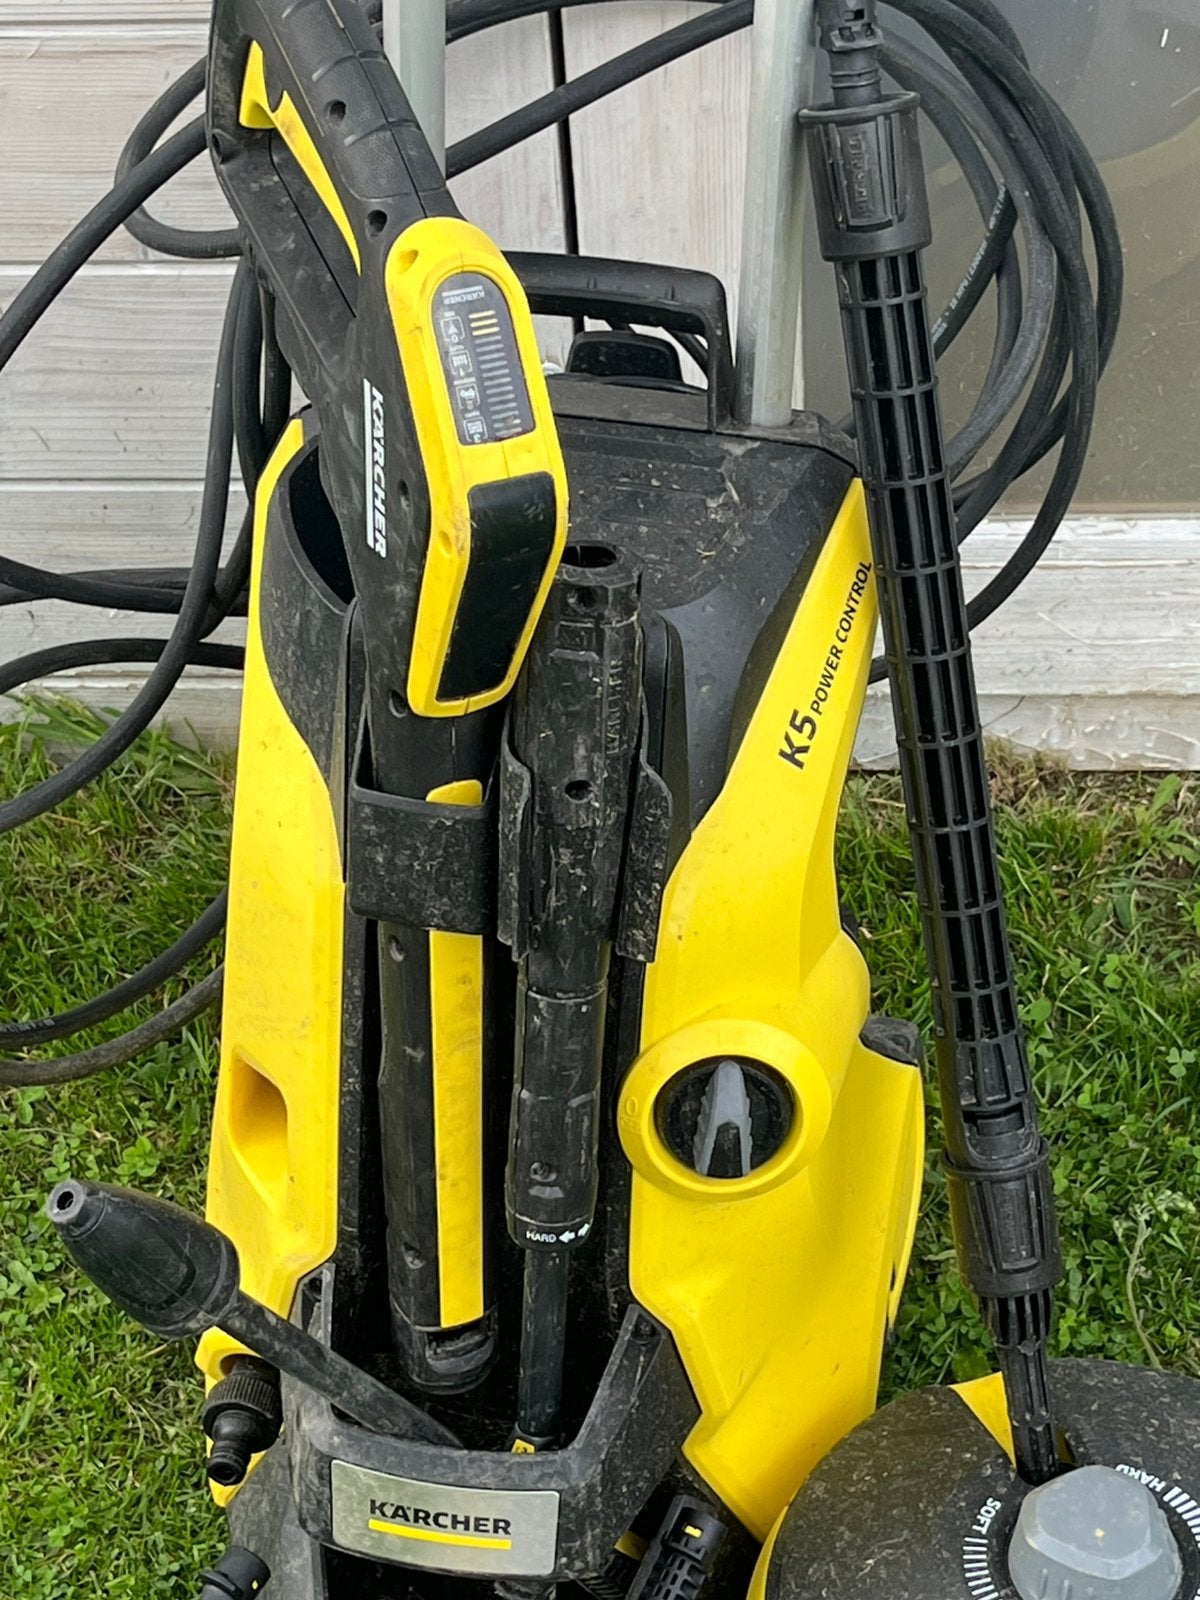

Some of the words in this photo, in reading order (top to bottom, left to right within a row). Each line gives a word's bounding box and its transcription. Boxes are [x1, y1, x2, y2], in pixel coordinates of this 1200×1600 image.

[778, 708, 818, 770] K5
[810, 644, 844, 716] POWER
[835, 560, 873, 644] CONTROL
[525, 1230, 557, 1243] HARD
[369, 1498, 512, 1536] KÄRCHER
[971, 1496, 1002, 1535] SOFT
